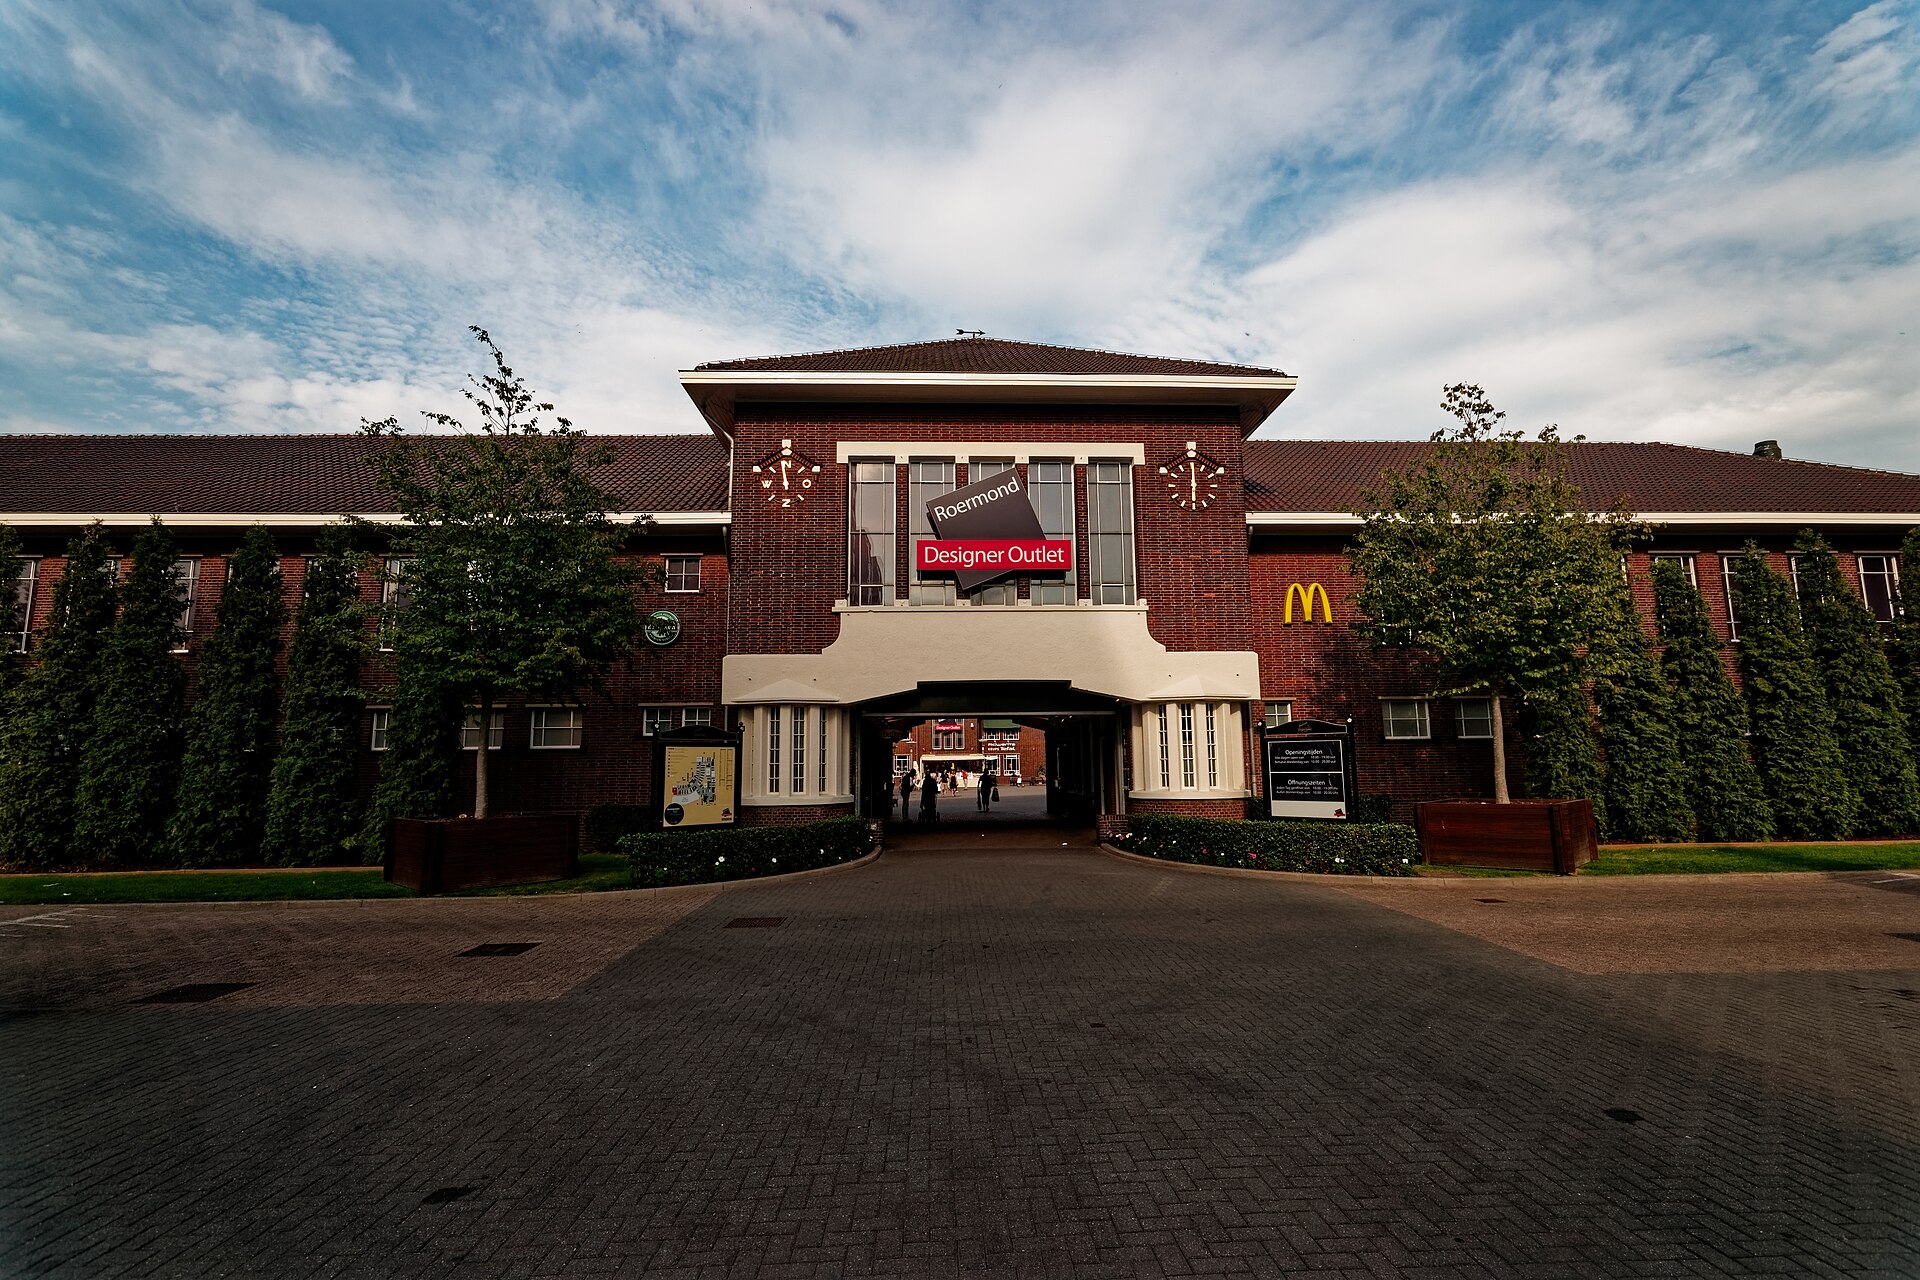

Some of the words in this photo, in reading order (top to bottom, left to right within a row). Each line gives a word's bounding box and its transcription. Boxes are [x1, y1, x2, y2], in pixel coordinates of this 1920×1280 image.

[761, 480, 773, 488] W
[934, 477, 1020, 522] Roermond
[924, 546, 1004, 567] Designer
[1008, 546, 1064, 563] Outlet
[1283, 582, 1332, 625] M
